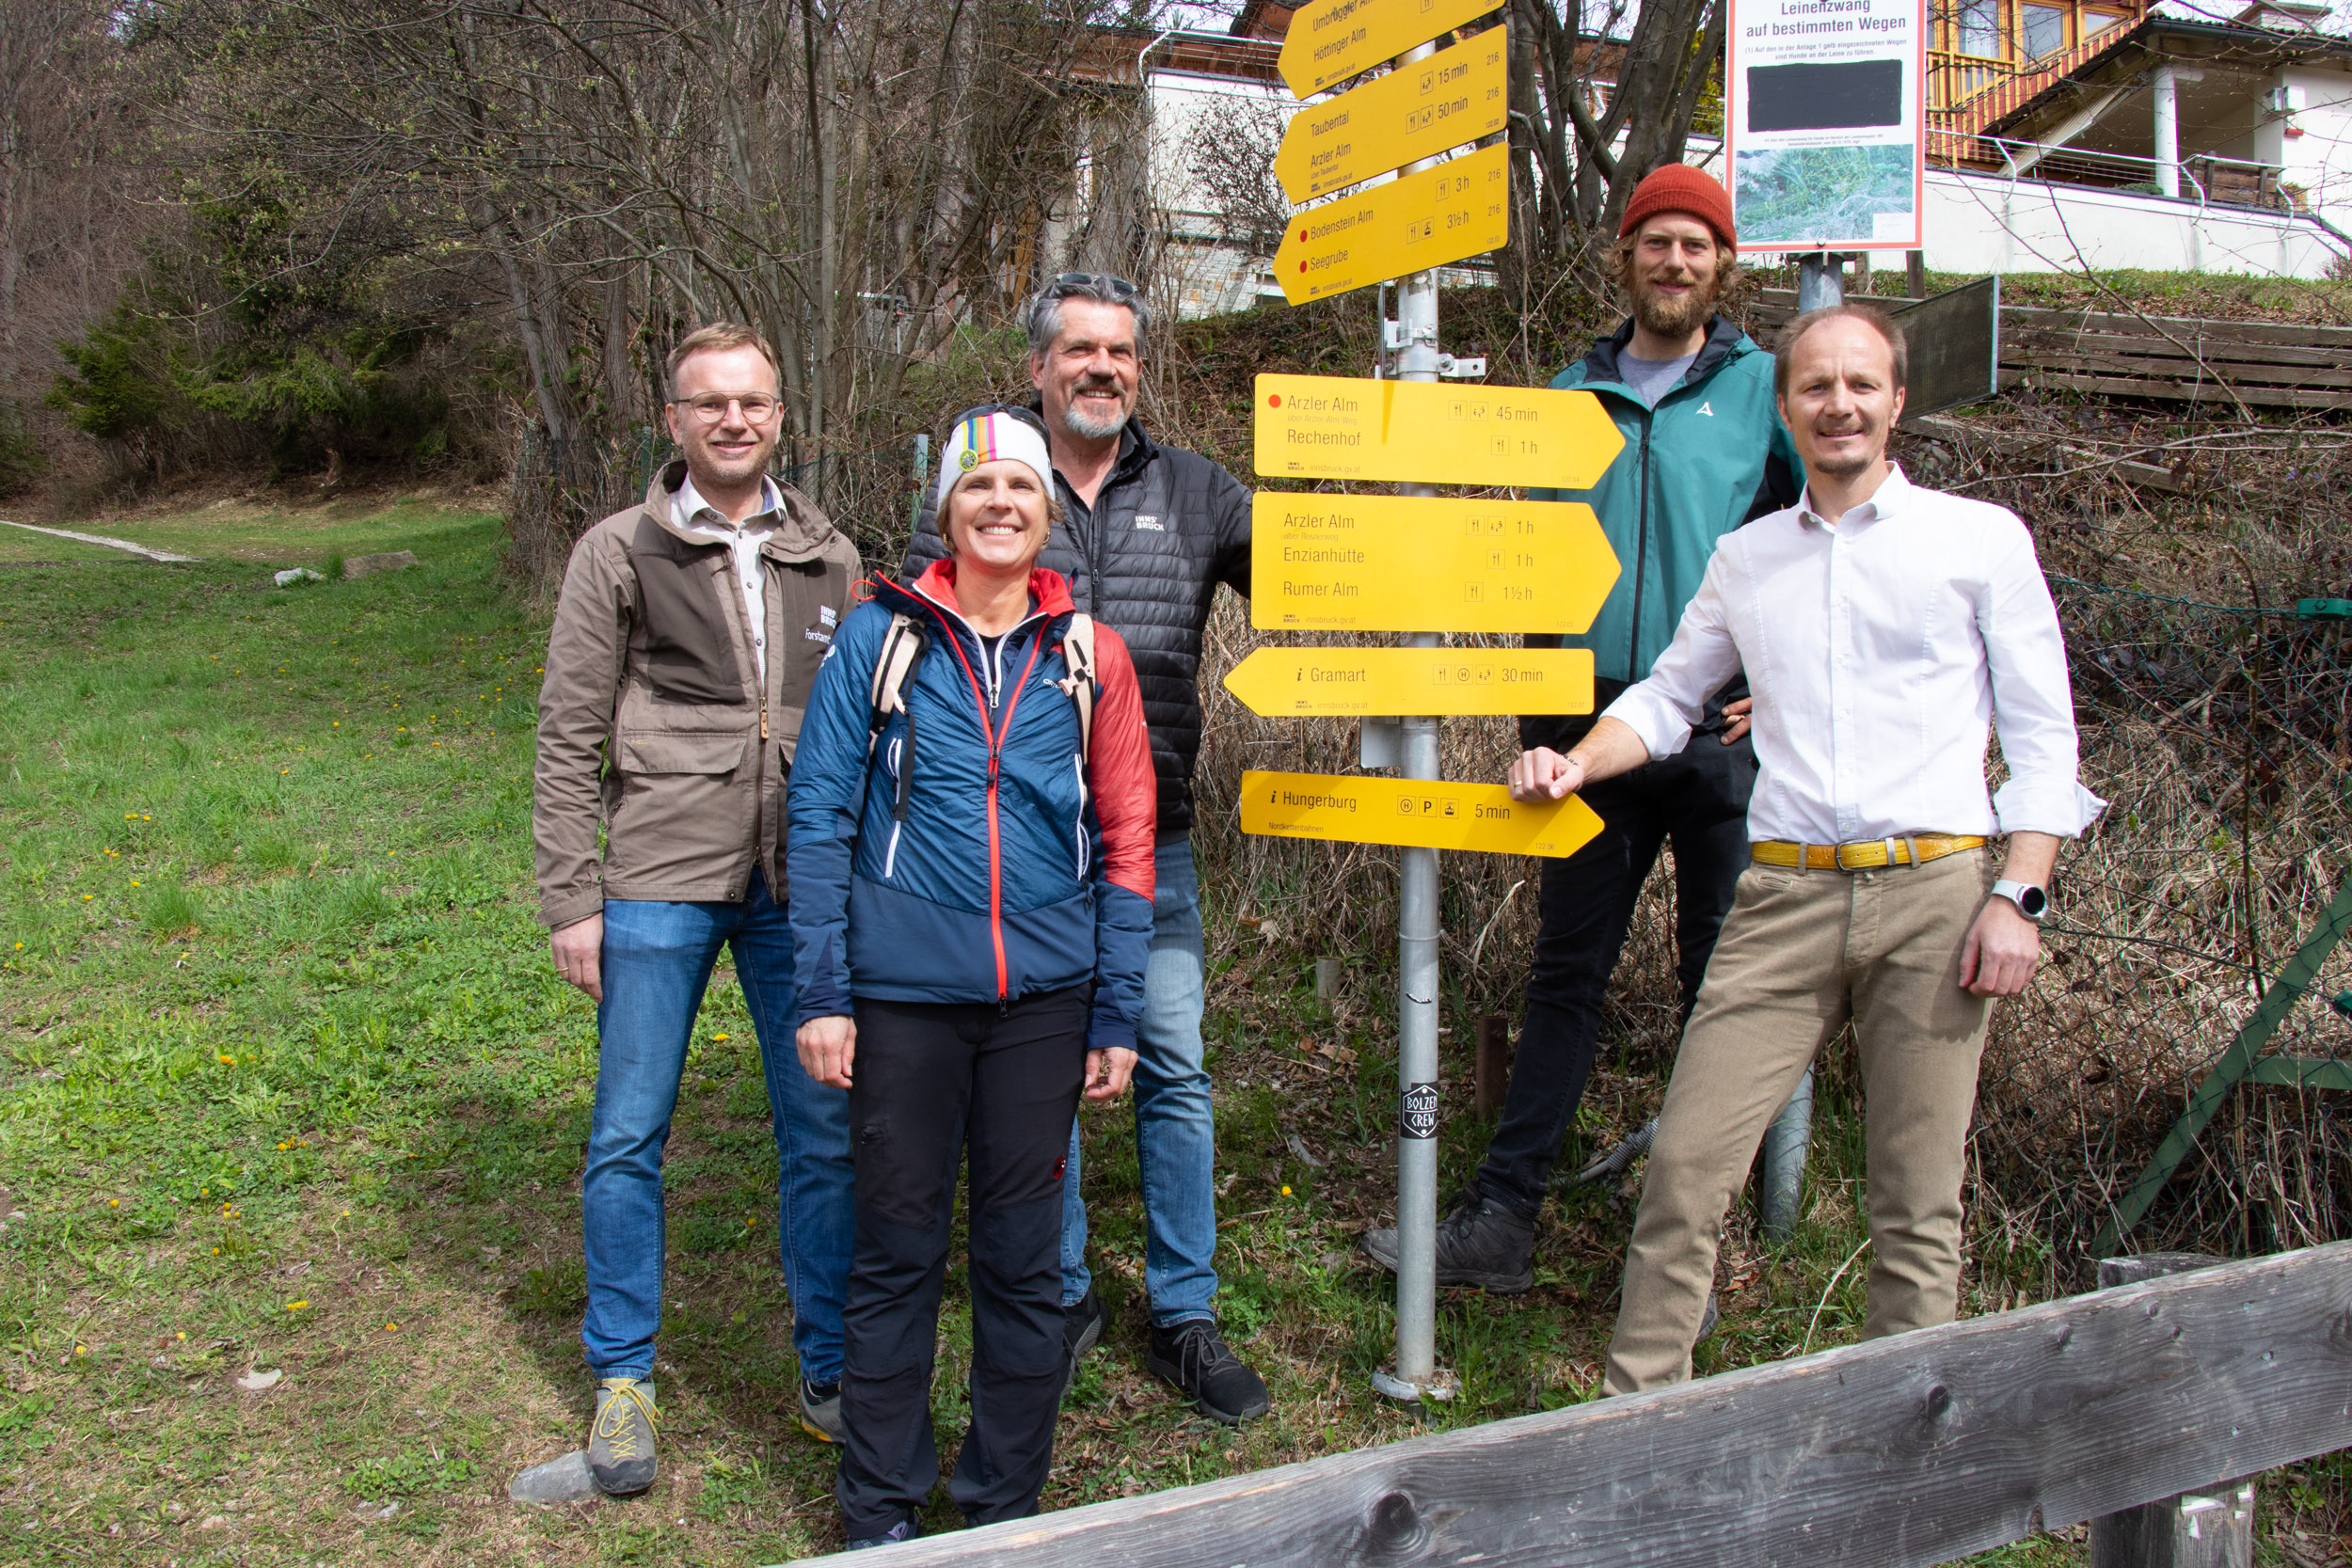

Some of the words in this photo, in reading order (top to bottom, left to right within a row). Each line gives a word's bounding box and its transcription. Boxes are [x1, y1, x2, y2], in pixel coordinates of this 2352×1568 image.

[1312, 0, 1357, 32] Umbrüggler
[1781, 0, 1870, 15] Leinenzwang
[1746, 23, 1767, 37] auf
[1772, 20, 1853, 36] bestimmten
[1858, 17, 1906, 32] Wegen
[1313, 36, 1349, 62] Höttinger
[1351, 27, 1366, 44] Alm
[1311, 109, 1349, 137] Taubental
[1438, 68, 1450, 85] 15
[1451, 62, 1468, 80] min
[1486, 52, 1500, 66] 216
[1311, 150, 1334, 168] Arzler
[1336, 143, 1351, 159] Alm
[1438, 102, 1450, 119] 50
[1451, 96, 1468, 114] min
[1486, 87, 1500, 101] 216
[1311, 214, 1356, 241] Bodenstein
[1358, 209, 1374, 225] Alm
[1455, 177, 1462, 193] 3
[1463, 176, 1470, 190] h
[1487, 168, 1501, 182] 216
[1310, 249, 1348, 271] Seegrube
[1463, 210, 1470, 225] h
[1487, 203, 1501, 217] 216
[1287, 395, 1328, 411] Arzler
[1332, 397, 1358, 412] Alm
[1496, 405, 1512, 420] 45
[1515, 407, 1538, 421] min
[1287, 429, 1361, 446] Rechenhof
[1520, 440, 1525, 453] 1
[1530, 440, 1537, 454] h
[1136, 522, 1165, 531] BRUCK
[1283, 513, 1325, 528] Arzler
[1328, 514, 1355, 529] Alm
[1517, 520, 1522, 534] 1
[1526, 520, 1534, 534] h
[1283, 546, 1365, 563] Enzianhütte
[1516, 553, 1521, 567] 1
[1526, 553, 1534, 567] h
[1283, 581, 1328, 596] Rumer
[1332, 582, 1359, 596] Alm
[1525, 586, 1533, 600] h
[1311, 667, 1366, 682] Gramart
[1502, 668, 1518, 682] 30
[1520, 668, 1543, 682] min
[1283, 790, 1357, 813] Hungerburg
[1423, 800, 1432, 813] P
[1475, 803, 1483, 818] 5
[1486, 805, 1510, 819] min
[1268, 821, 1324, 832] Nordkettenbahnen
[1406, 1095, 1438, 1110] BOLZEN
[1411, 1113, 1435, 1127] CREW
